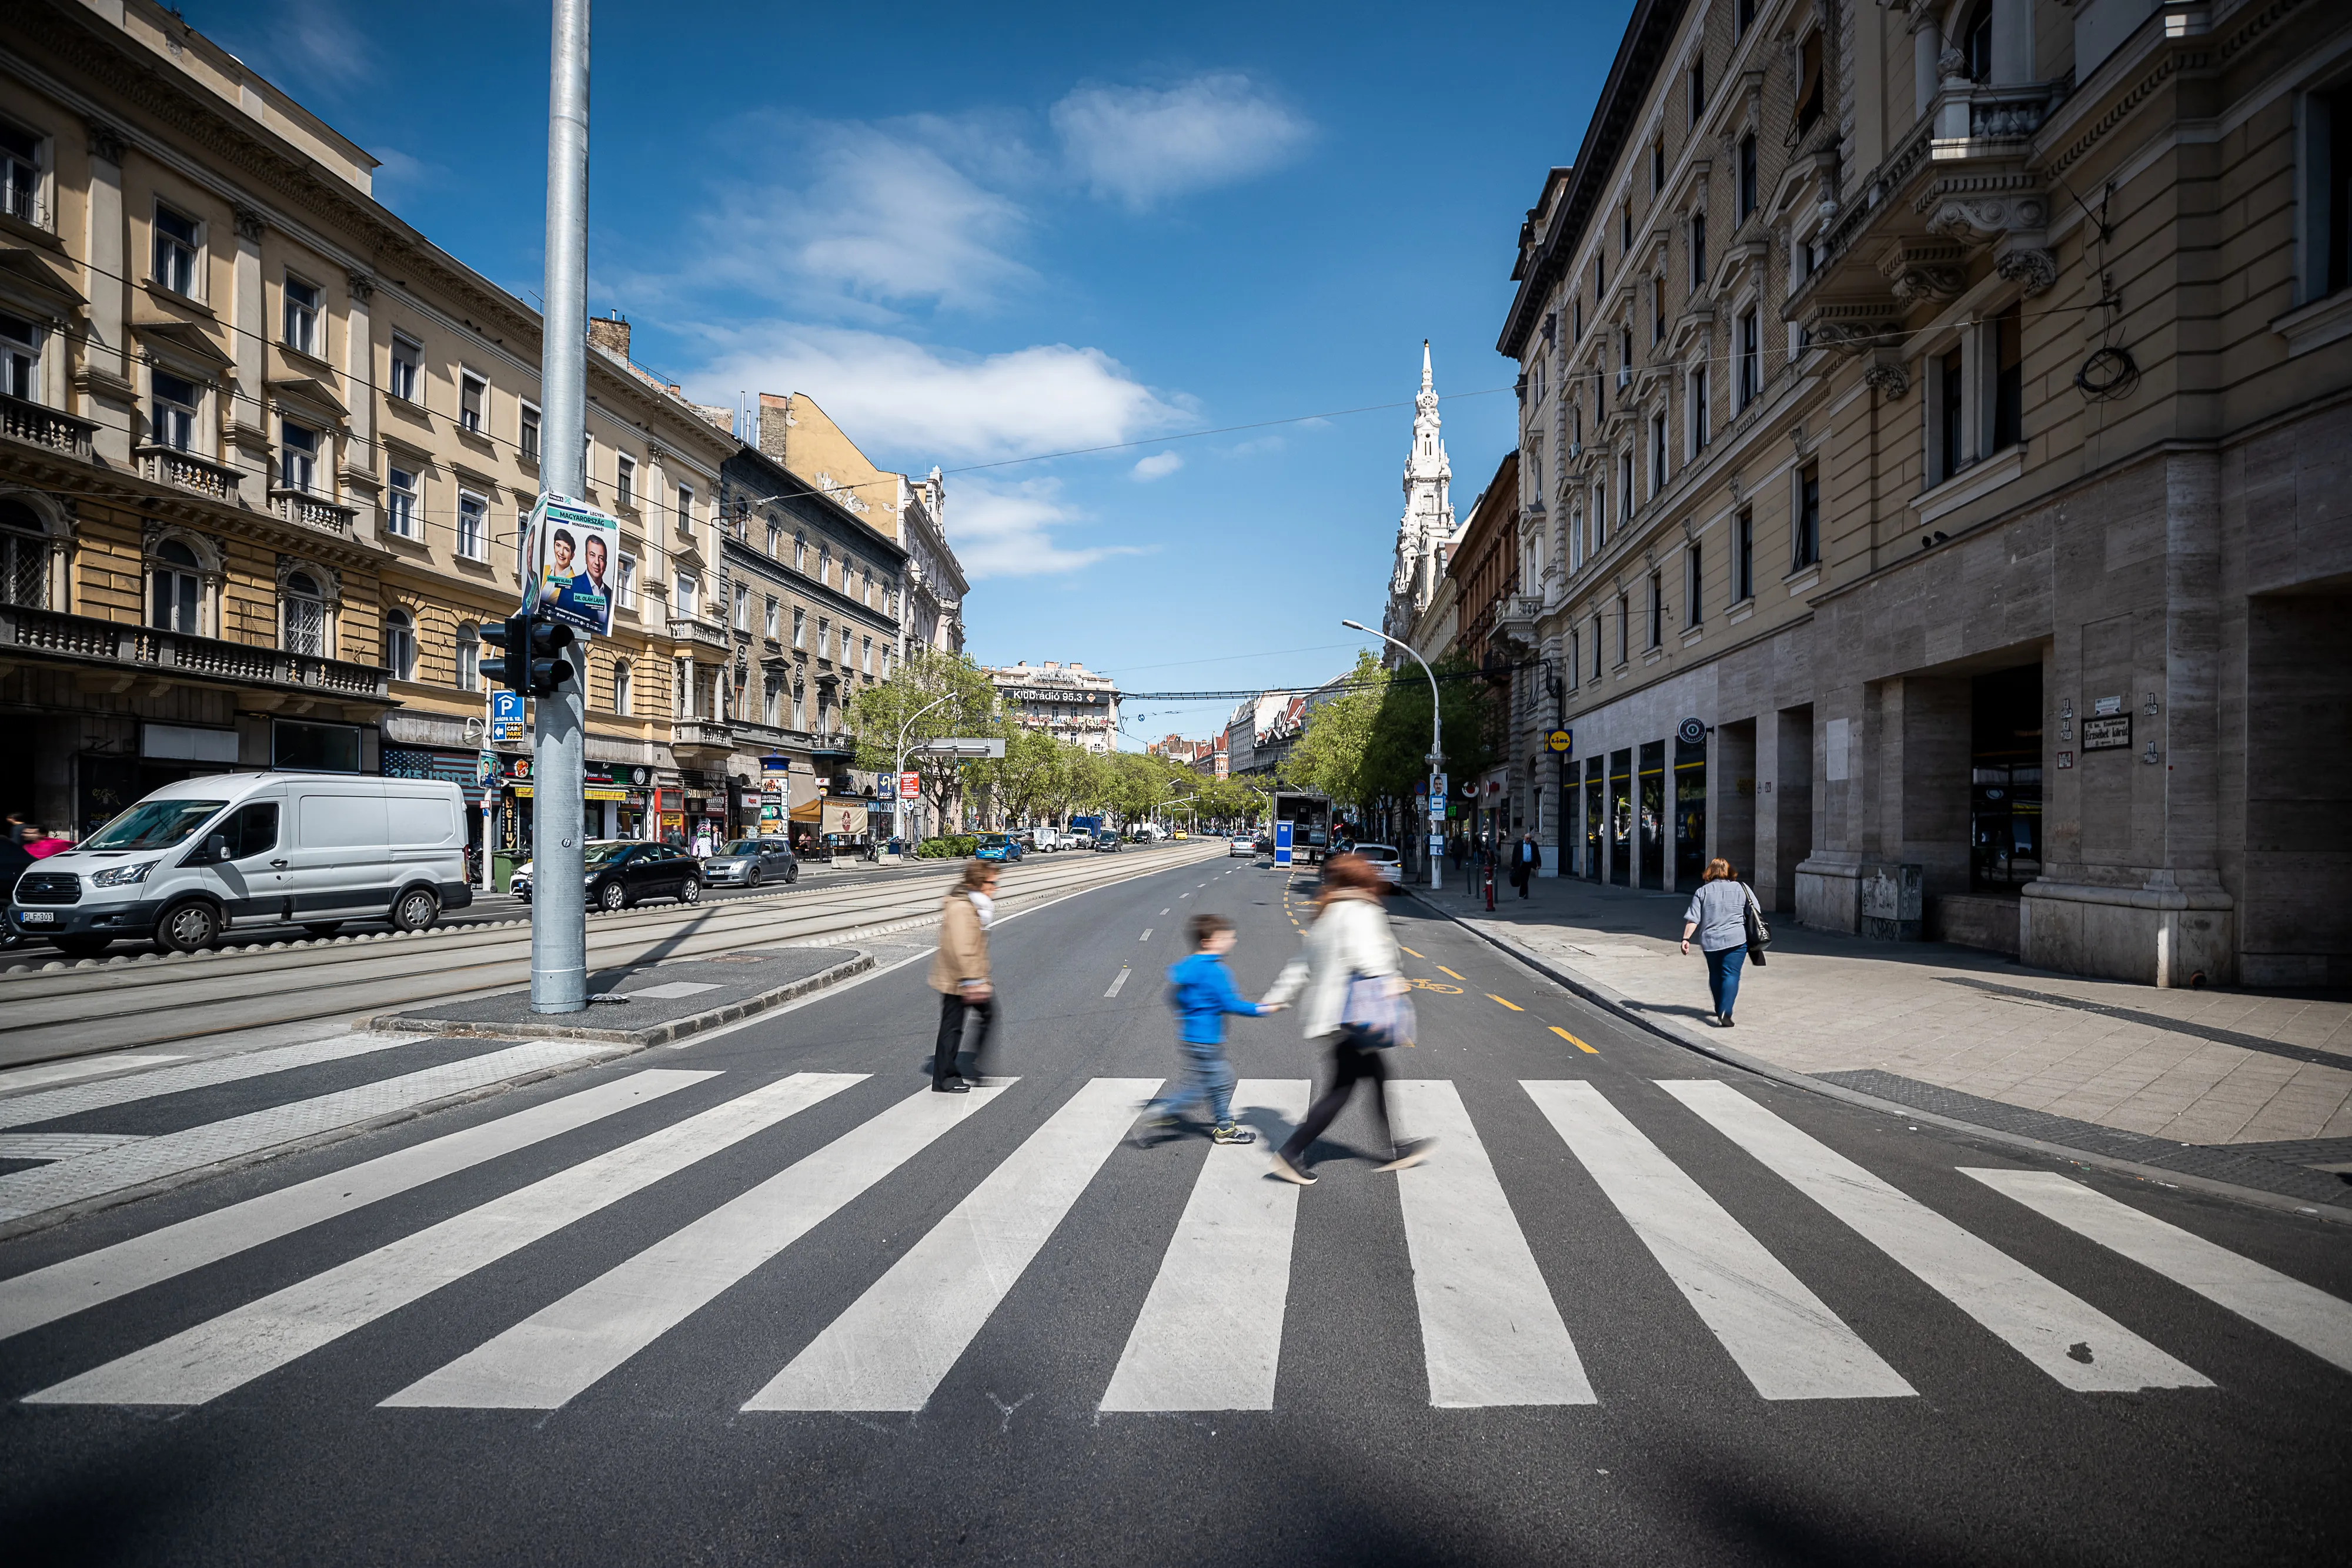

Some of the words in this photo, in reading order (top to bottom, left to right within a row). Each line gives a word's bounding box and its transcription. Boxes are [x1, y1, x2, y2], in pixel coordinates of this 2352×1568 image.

[560, 511, 604, 526] MAGYARORSZÁG
[572, 522, 604, 531] MINDANNYIUNKÉ!
[1013, 690, 1060, 701] Klubrádió
[1062, 693, 1083, 701] 95.3
[501, 700, 513, 716] P
[2086, 728, 2109, 741] Erzsébet
[2112, 726, 2128, 737] körút
